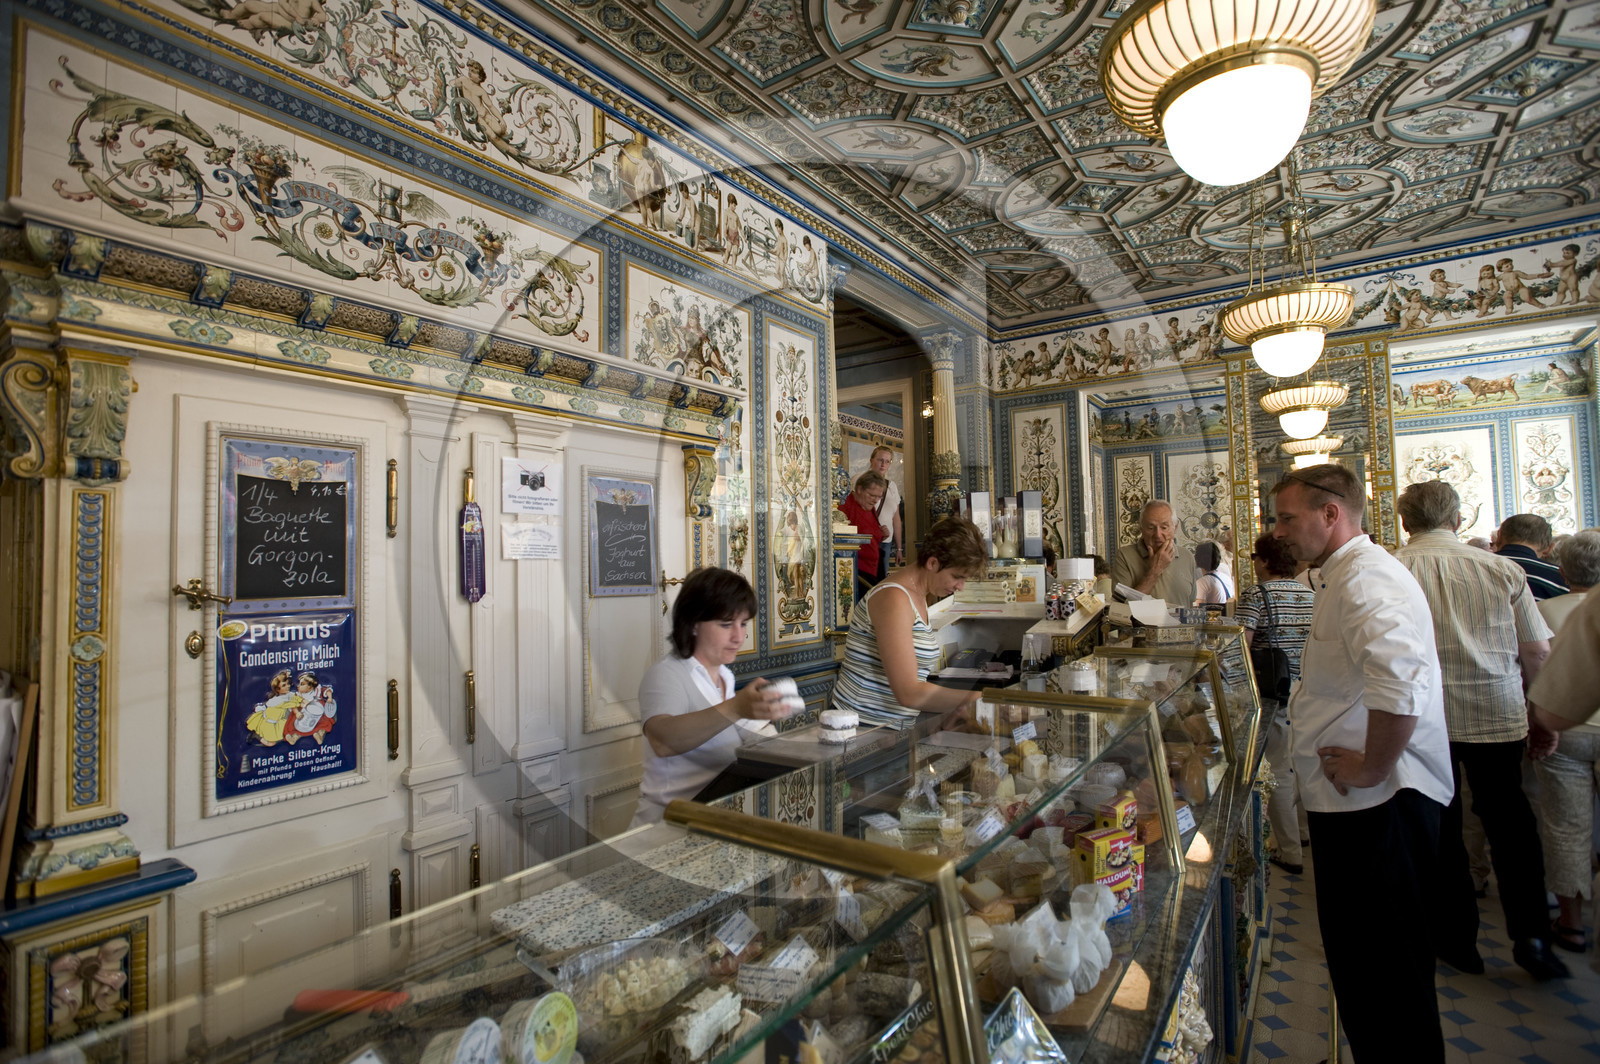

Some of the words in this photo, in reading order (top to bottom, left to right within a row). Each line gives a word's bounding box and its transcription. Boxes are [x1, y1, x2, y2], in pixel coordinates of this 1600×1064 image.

[242, 482, 278, 506] 1/4
[243, 505, 333, 529] Baguette
[264, 527, 310, 543] mit
[248, 544, 334, 572] Gorgon-
[606, 545, 646, 563] Joghurt
[283, 565, 335, 588] zola
[605, 570, 647, 582] Sachsen
[250, 620, 331, 643] Pfunds
[240, 647, 309, 667] Condensirte
[312, 643, 340, 660] Milch
[297, 659, 334, 671] Dresden
[253, 754, 285, 768] Marke
[288, 743, 341, 762] Silber-Krug
[258, 768, 269, 776] mit
[270, 764, 292, 773] Pfunds
[294, 760, 314, 768] Dosen
[237, 770, 296, 788] Kindernahrung!
[1096, 867, 1131, 885] HALLOUMI
